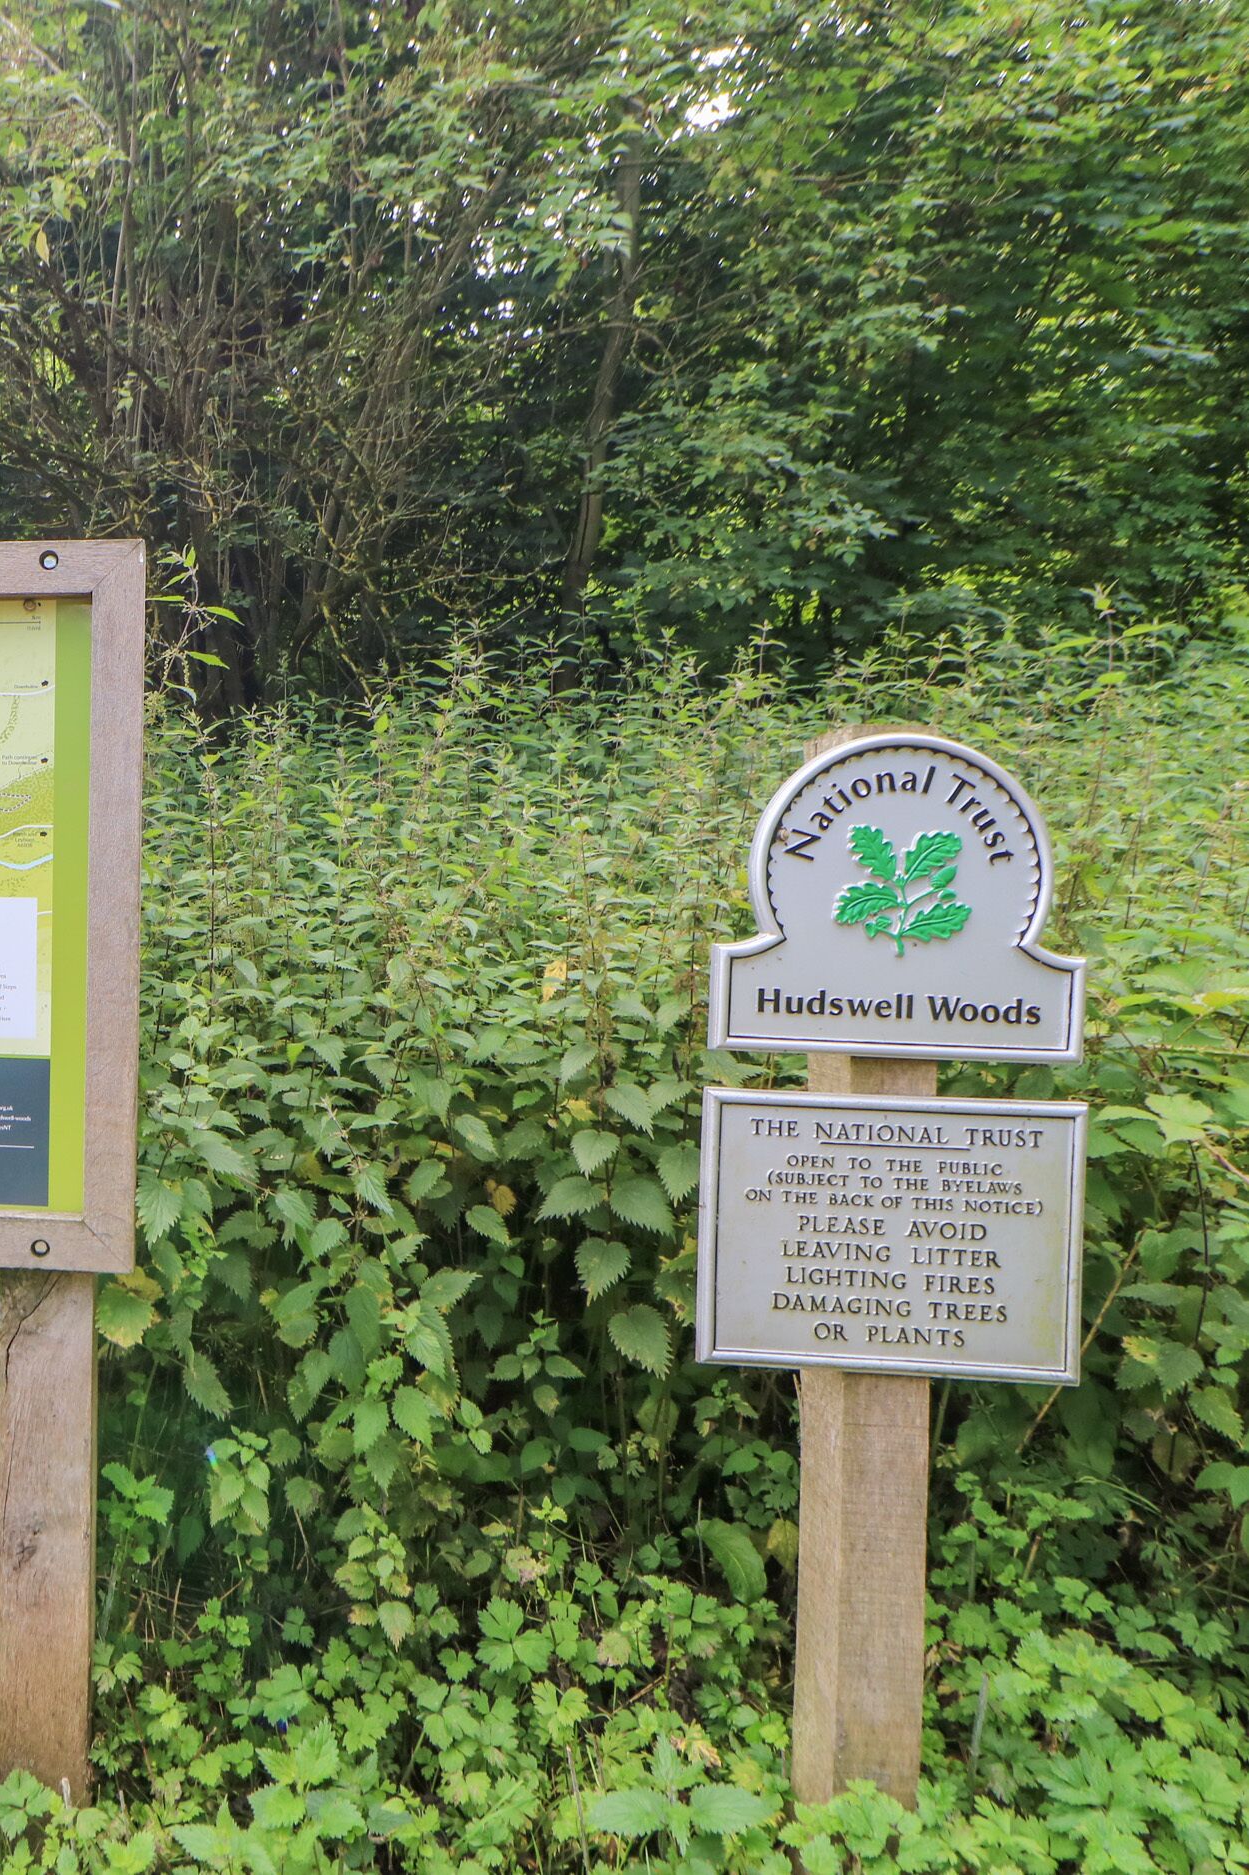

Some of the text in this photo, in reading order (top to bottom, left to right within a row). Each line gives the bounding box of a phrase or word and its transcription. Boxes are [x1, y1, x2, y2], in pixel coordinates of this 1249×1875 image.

[784, 766, 1014, 866] National Trust
[757, 988, 1041, 1024] Hudswell Woods
[751, 1118, 1043, 1148] THE NATIONAL TRUST
[787, 1154, 1002, 1176] OPEN TO THE PUBLIC
[767, 1169, 1022, 1195] (SUBJECT TO THE BYELAWS
[744, 1188, 1043, 1216] ON THE BACK OF THIS NOTICE)
[798, 1214, 987, 1241] PLEASE AVOID
[780, 1239, 1001, 1268] LEAVING LITTER
[785, 1265, 995, 1295] LIGHTING FIRES
[772, 1292, 1008, 1323] DAMAGING TREES
[814, 1322, 965, 1348] OR PLANTS
